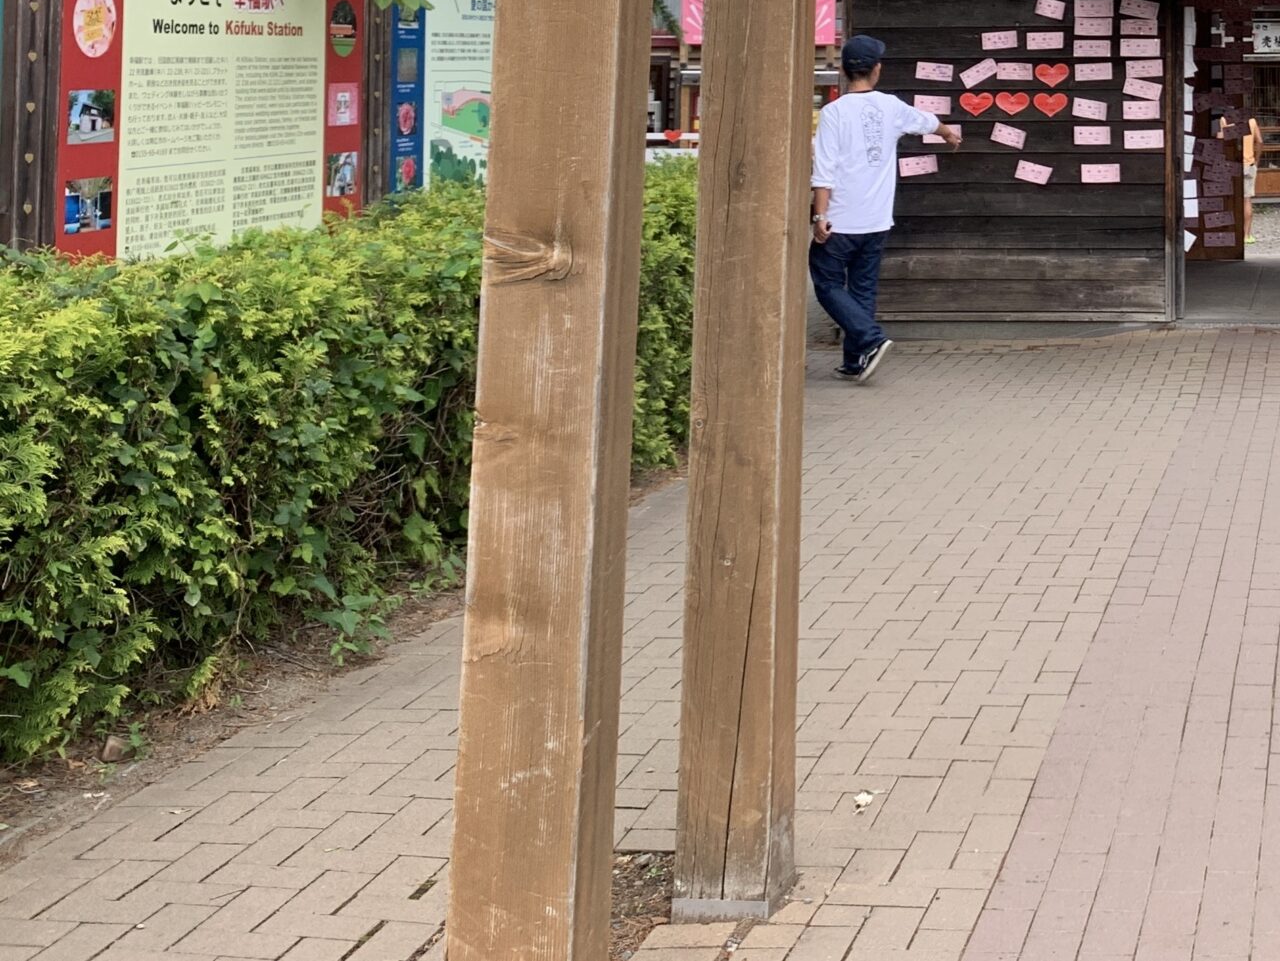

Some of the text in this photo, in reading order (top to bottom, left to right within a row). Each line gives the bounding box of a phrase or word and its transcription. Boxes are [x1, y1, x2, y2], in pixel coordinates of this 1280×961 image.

[153, 19, 205, 35] Welcome
[208, 21, 220, 35] to
[266, 21, 303, 37] Station
